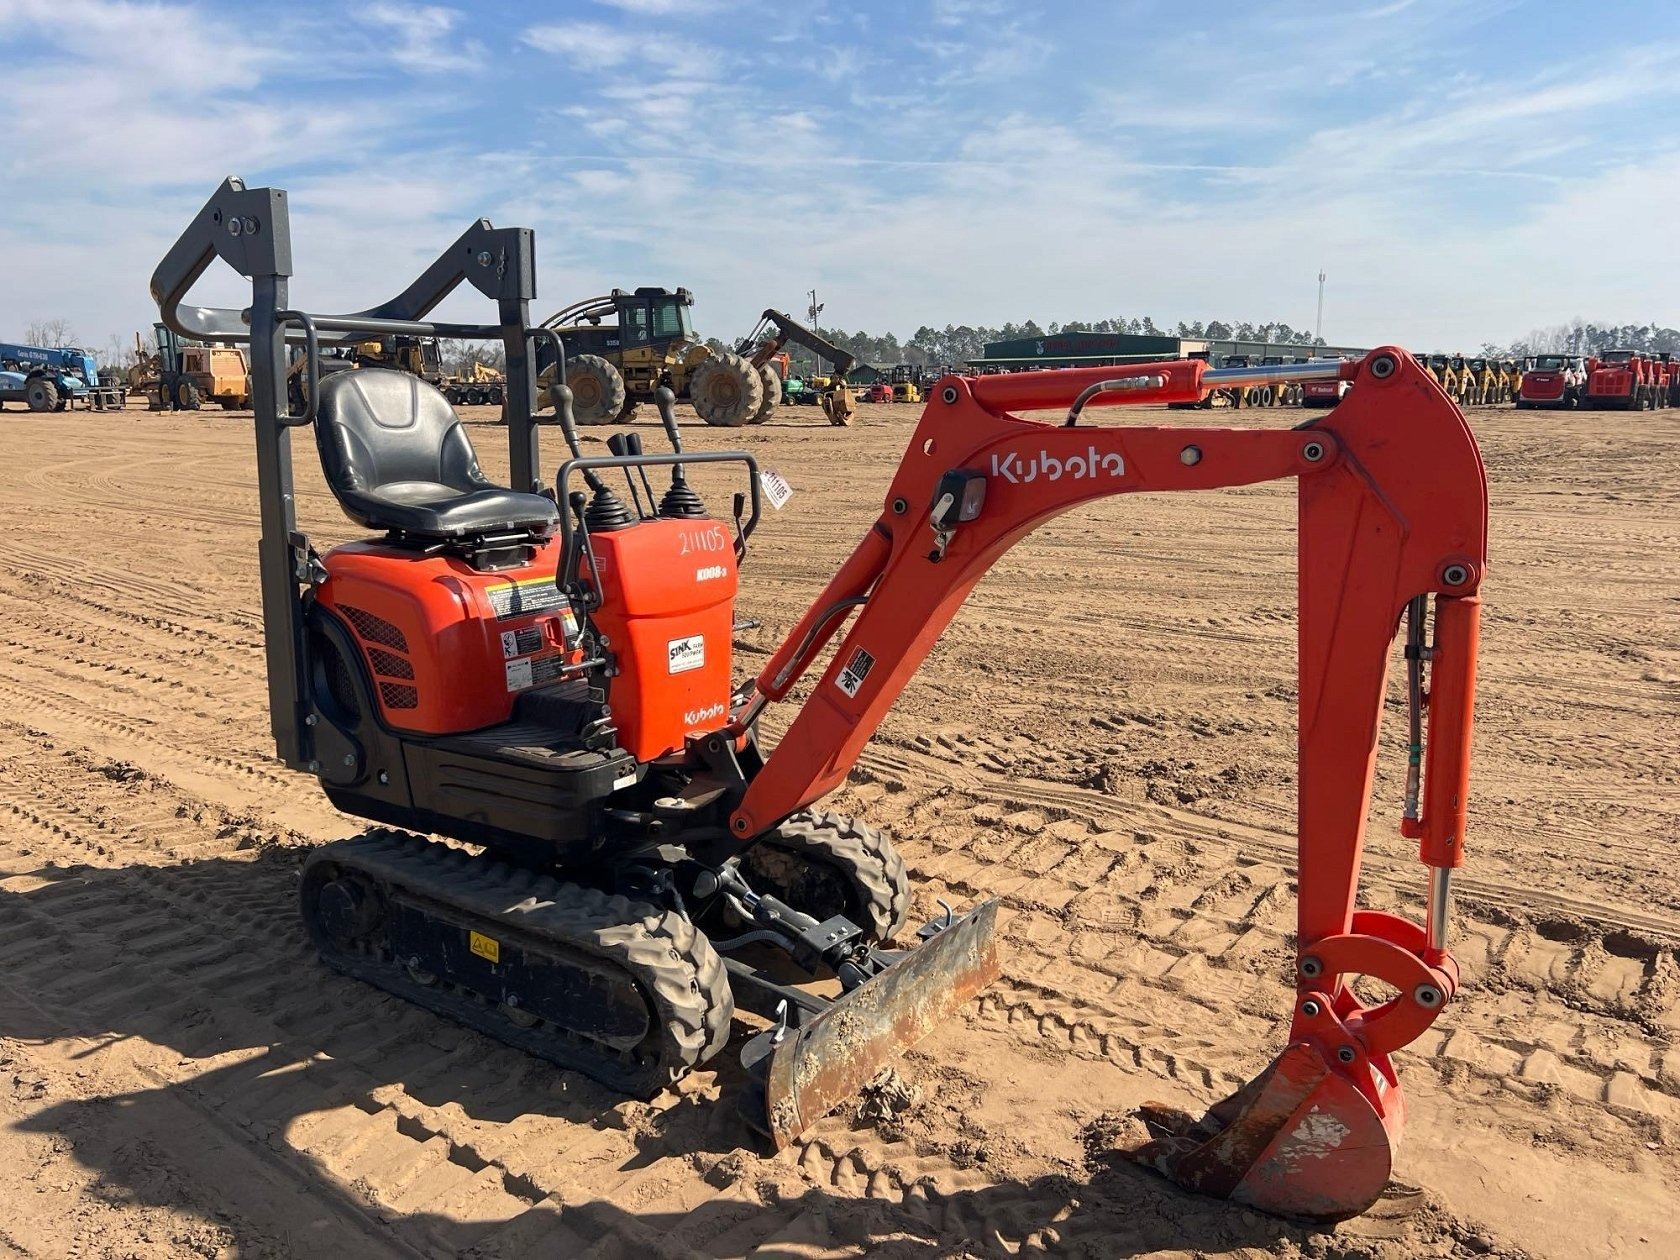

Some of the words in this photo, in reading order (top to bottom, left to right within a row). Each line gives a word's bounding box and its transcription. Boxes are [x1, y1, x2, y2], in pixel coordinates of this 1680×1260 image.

[991, 446, 1125, 484] Kubota
[679, 526, 725, 556] 211105
[696, 565, 727, 582] K008-3
[670, 639, 692, 660] SINK
[684, 703, 724, 725] Kubota
